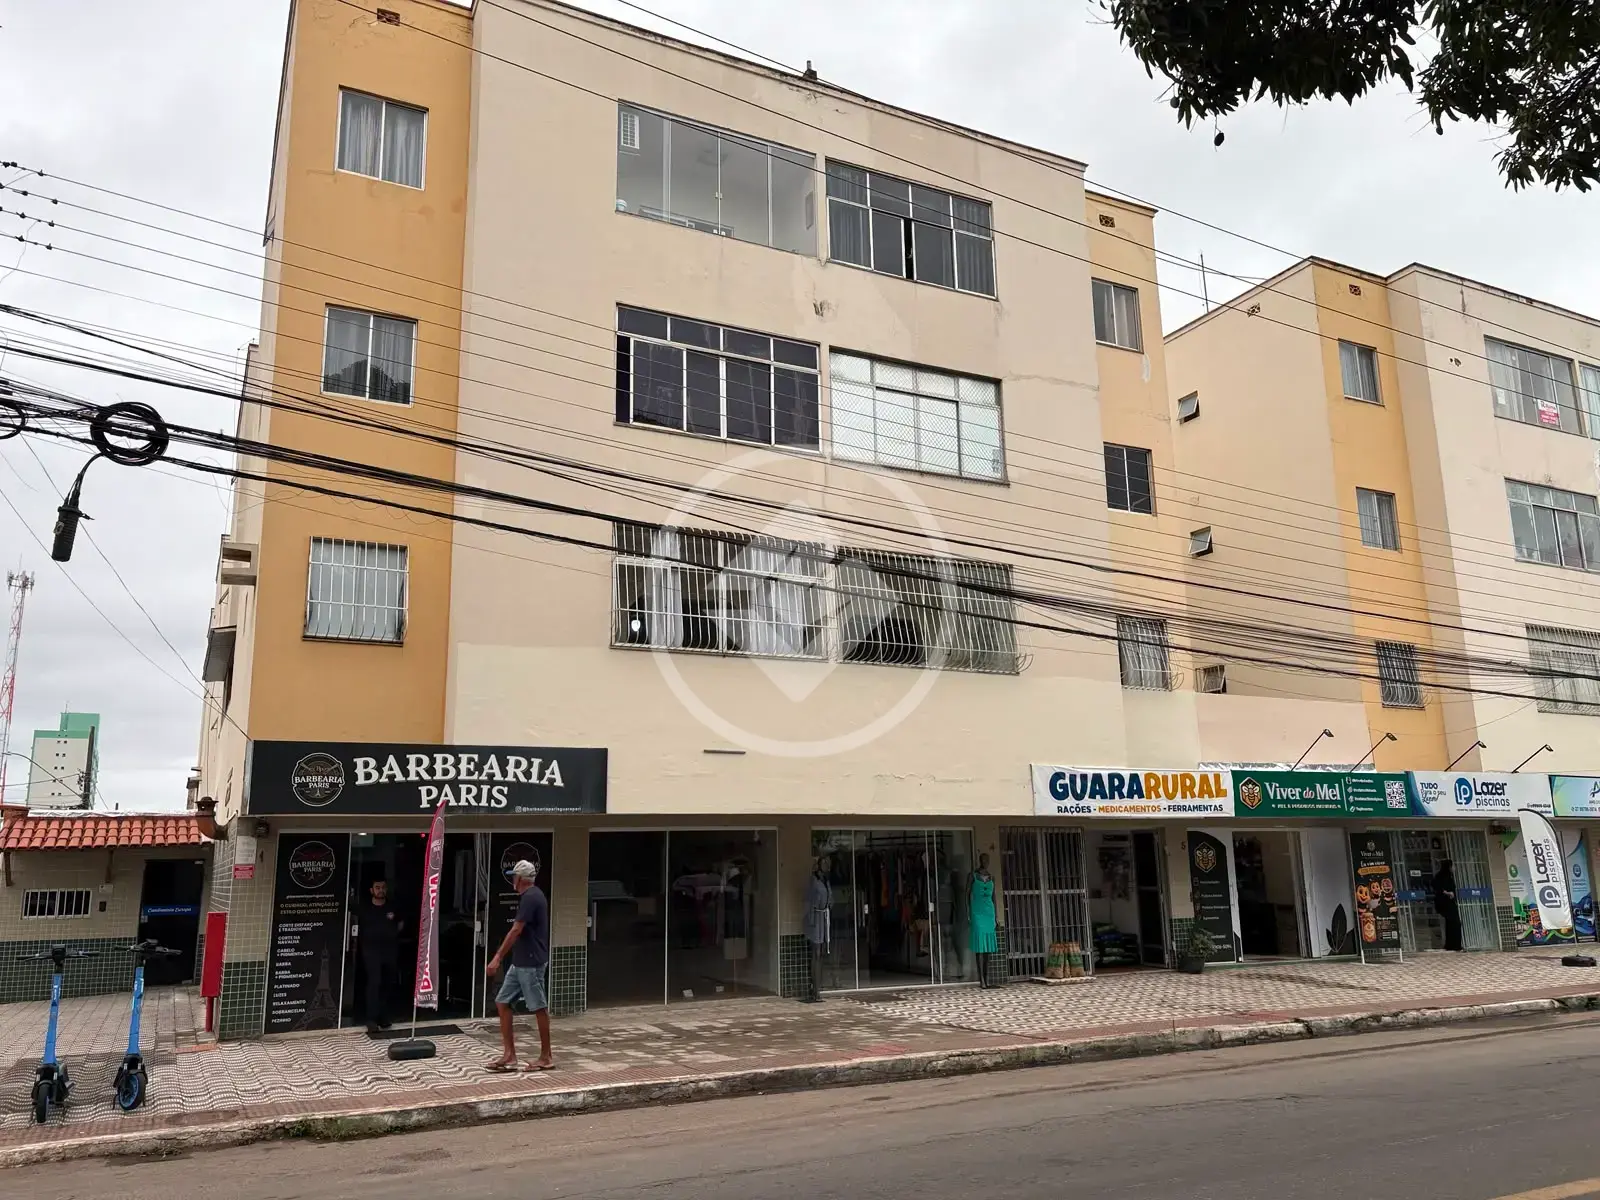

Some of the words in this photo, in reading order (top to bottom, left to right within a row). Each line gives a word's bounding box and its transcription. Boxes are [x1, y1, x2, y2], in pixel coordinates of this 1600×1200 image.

[294, 775, 344, 784] BARBEARIA
[353, 753, 565, 788] BARBEARIA
[419, 783, 509, 809] PARIS
[1264, 782, 1302, 800] Viver
[1303, 787, 1315, 799] do
[1316, 783, 1342, 800] Mel
[1473, 778, 1508, 796] Lazer
[1057, 803, 1092, 815] RAÇÕES
[1098, 804, 1162, 813] MEDICAMENTOS
[1168, 804, 1224, 813] FERRAMENTAS
[1475, 795, 1511, 808] piscinas
[292, 861, 334, 869] BARBEARIA
[1530, 839, 1551, 884] Lazer
[1543, 838, 1560, 883] piscinas
